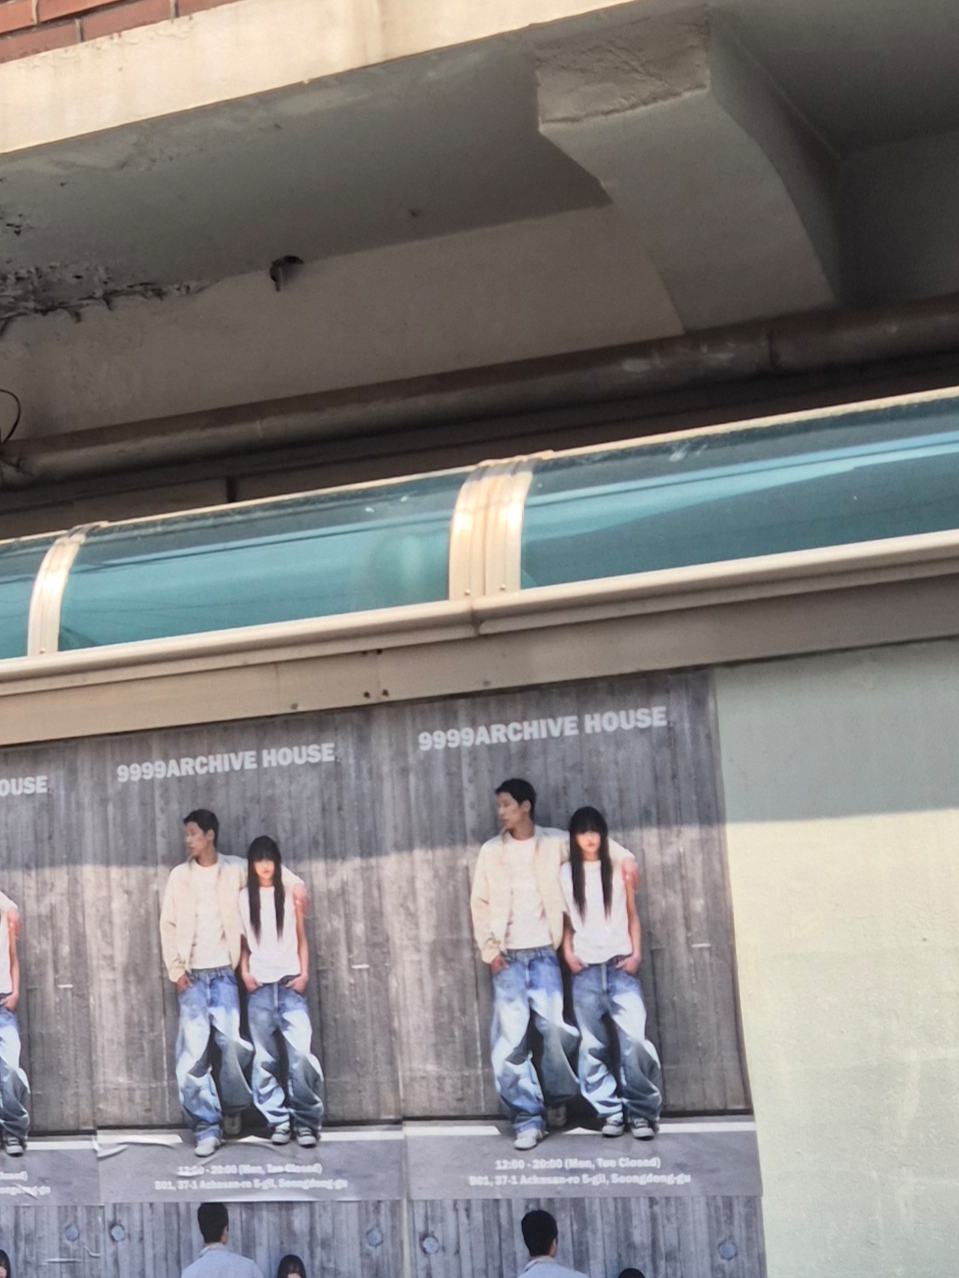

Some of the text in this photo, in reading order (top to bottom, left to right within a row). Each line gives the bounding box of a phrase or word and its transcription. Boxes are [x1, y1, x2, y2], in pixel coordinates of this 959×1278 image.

[418, 706, 668, 752] 9999ARCHIVE HOUSE
[117, 742, 335, 782] 9999ARCHIVE HOUSE
